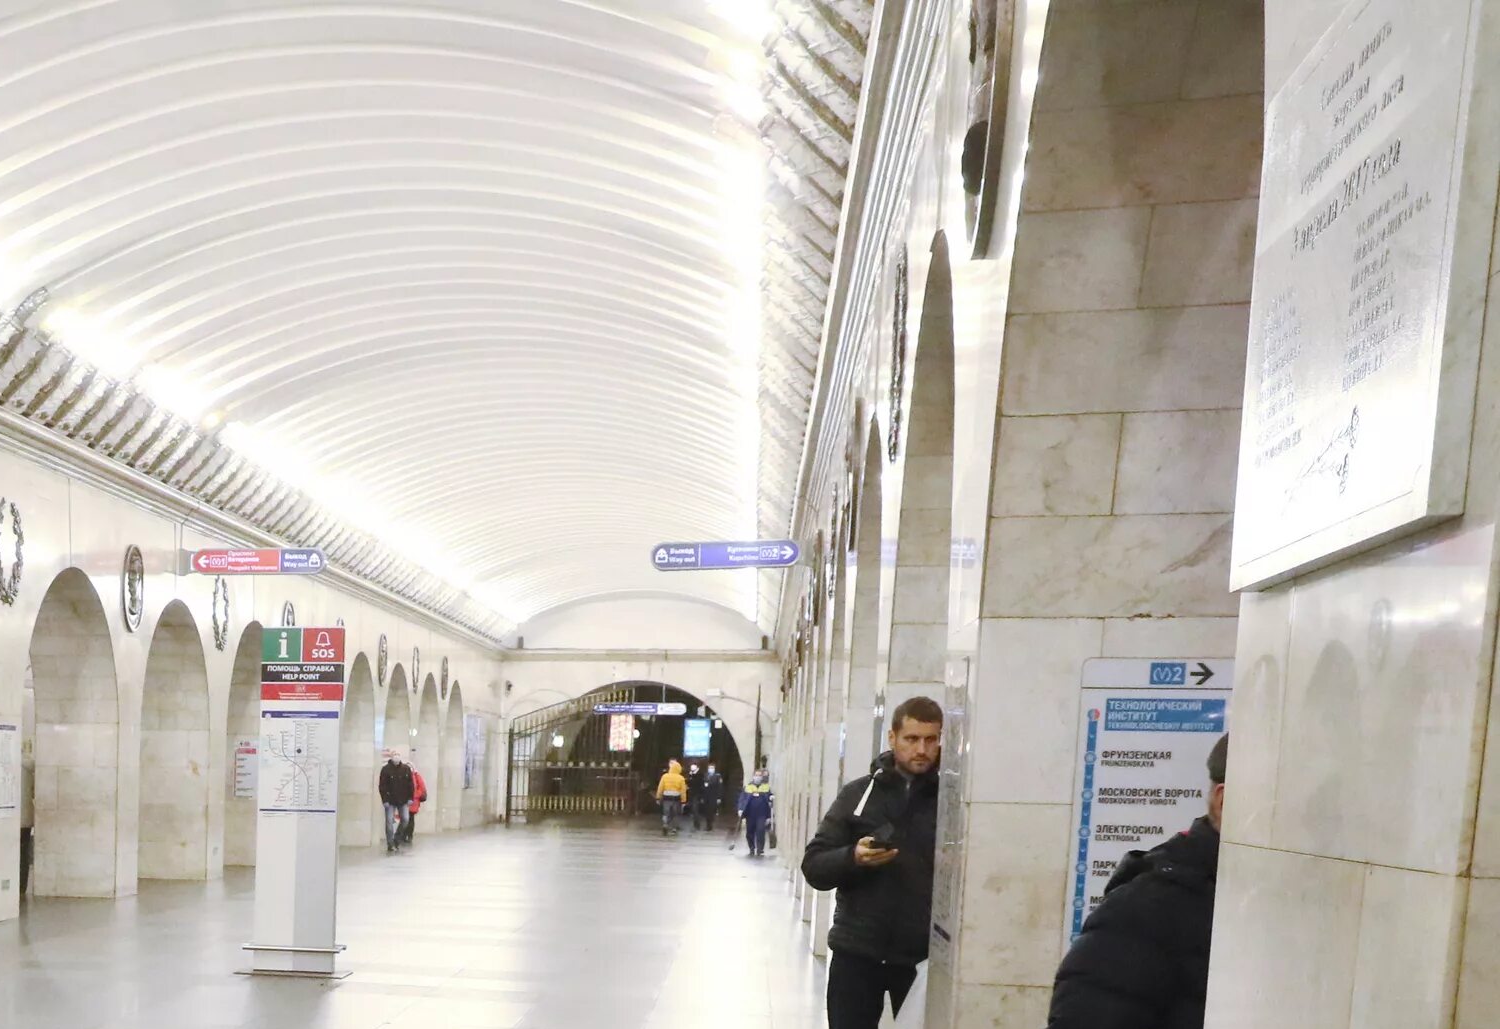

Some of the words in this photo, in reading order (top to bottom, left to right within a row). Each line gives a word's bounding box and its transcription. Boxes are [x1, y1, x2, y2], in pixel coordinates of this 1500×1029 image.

[1340, 156, 1371, 213] 2017
[1371, 137, 1401, 185] года
[312, 649, 335, 658] SOS
[1109, 700, 1202, 712] ТЕХНОЛОГИЧЕСКИЙ
[1108, 711, 1158, 721] ИНСТИТУТ
[1101, 750, 1172, 760] ФРУНЗЕНСКАЯ
[1101, 760, 1155, 768] FRUNZENSKAYA
[1099, 788, 1162, 798] МОСКОВСКИЕ
[1164, 789, 1203, 799] ВОРОТА
[1098, 797, 1147, 805] MOSKOVSKIYE
[1149, 798, 1177, 806] VOROTA
[1096, 825, 1164, 835] ЭЛЕКТРОСИЛА
[1092, 861, 1117, 869] ПАРК
